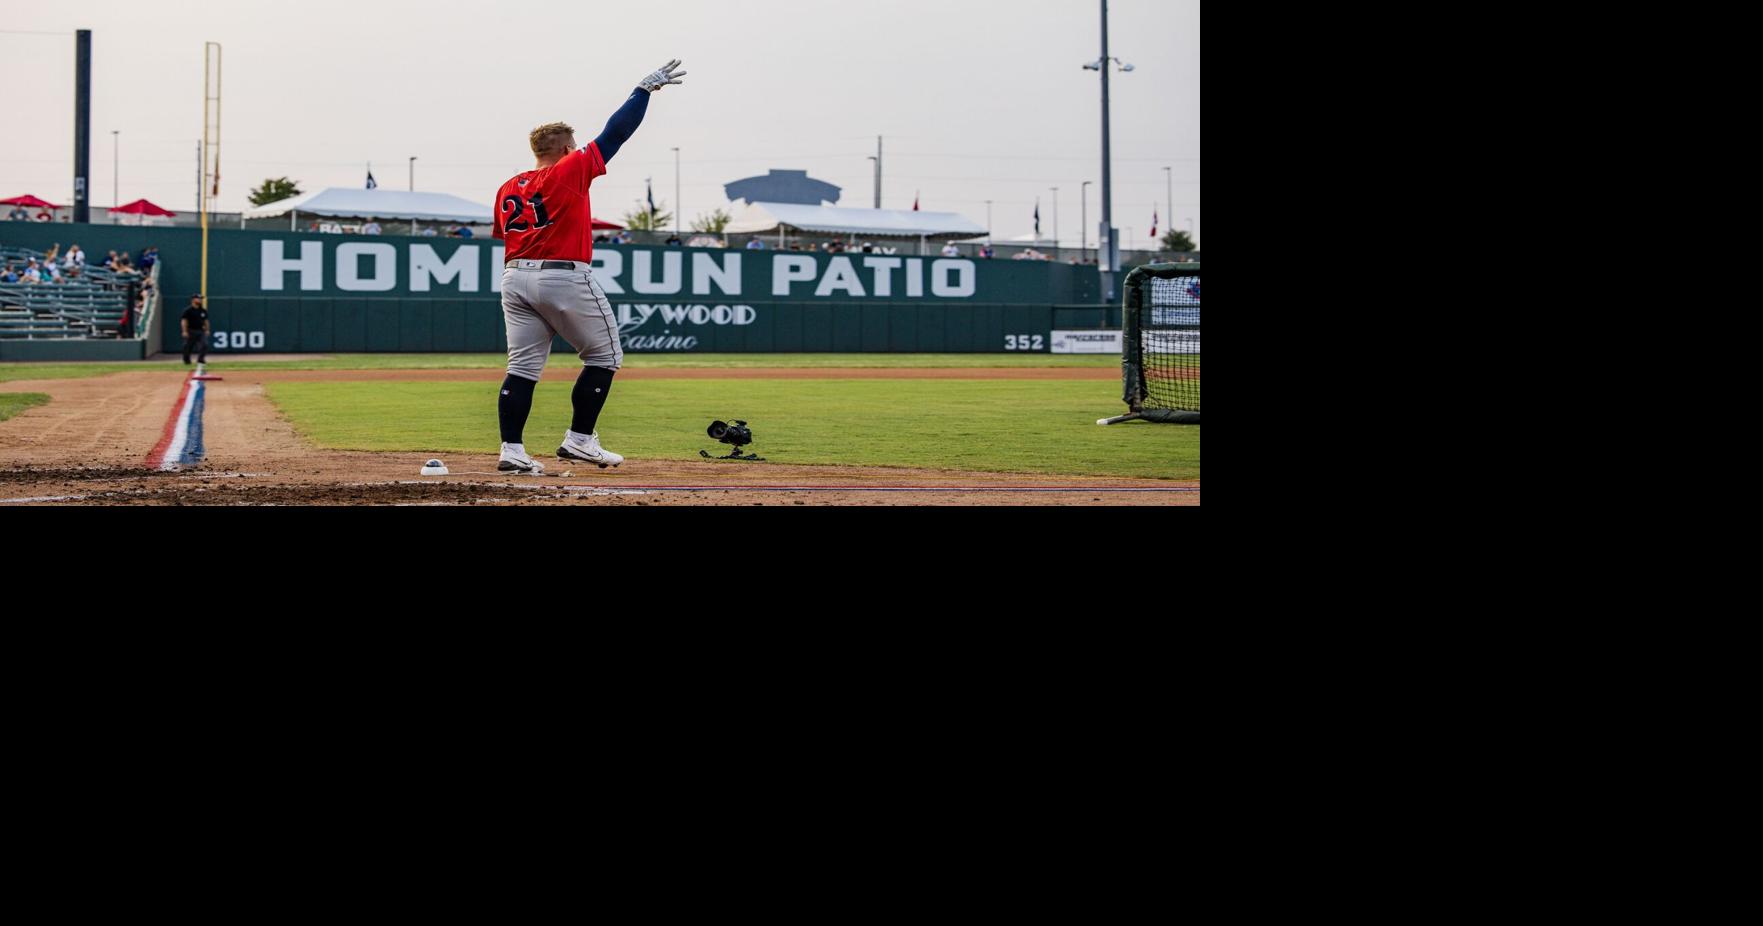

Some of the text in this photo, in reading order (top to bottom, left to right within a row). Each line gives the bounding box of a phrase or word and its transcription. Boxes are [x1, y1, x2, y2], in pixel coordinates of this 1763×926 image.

[501, 193, 554, 234] 21
[260, 239, 976, 298] HOM RUN PATIO
[213, 331, 265, 348] 300
[1004, 334, 1044, 350] 352
